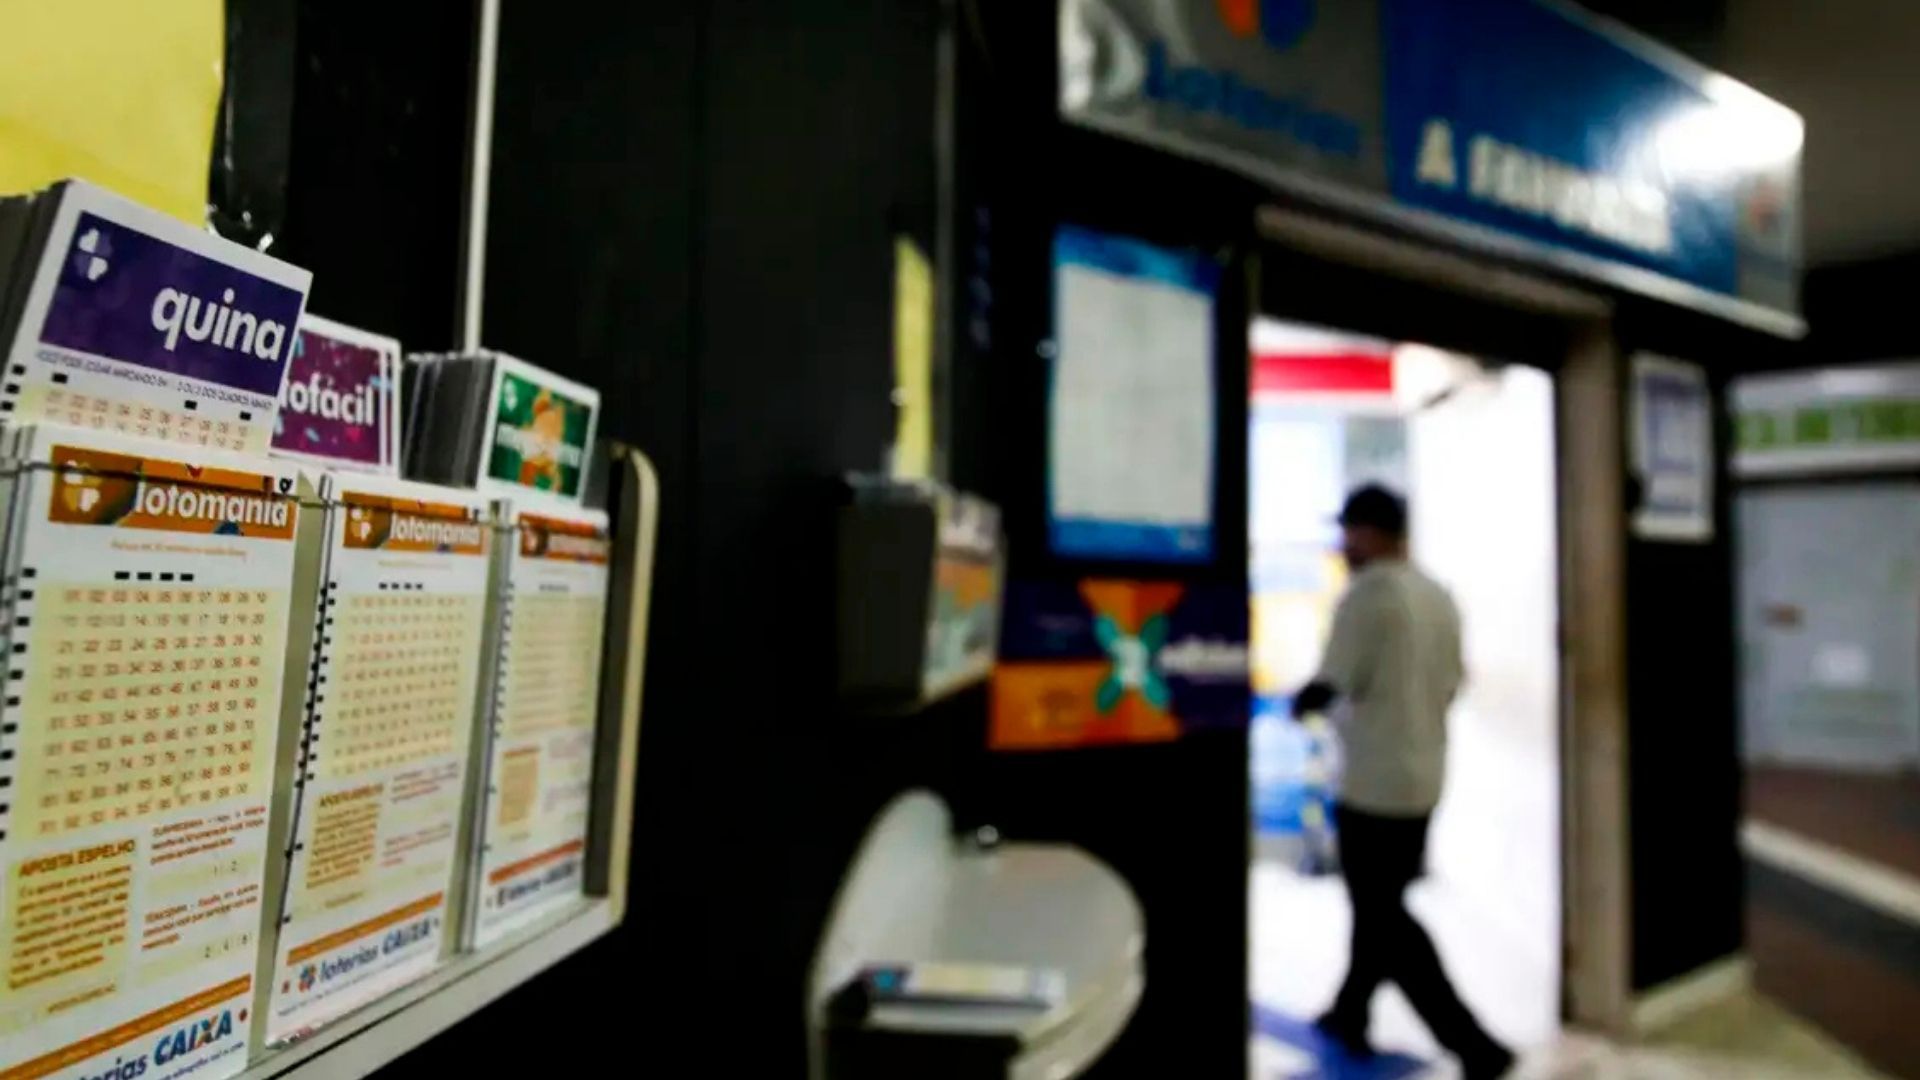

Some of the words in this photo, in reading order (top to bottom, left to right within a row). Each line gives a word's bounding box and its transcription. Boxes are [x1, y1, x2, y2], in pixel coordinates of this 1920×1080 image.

[151, 286, 286, 361] quina
[135, 480, 287, 527] lotomania
[78, 839, 135, 865] ESPELHO
[80, 1054, 149, 1080] rias
[154, 1010, 233, 1066] CAIXA
